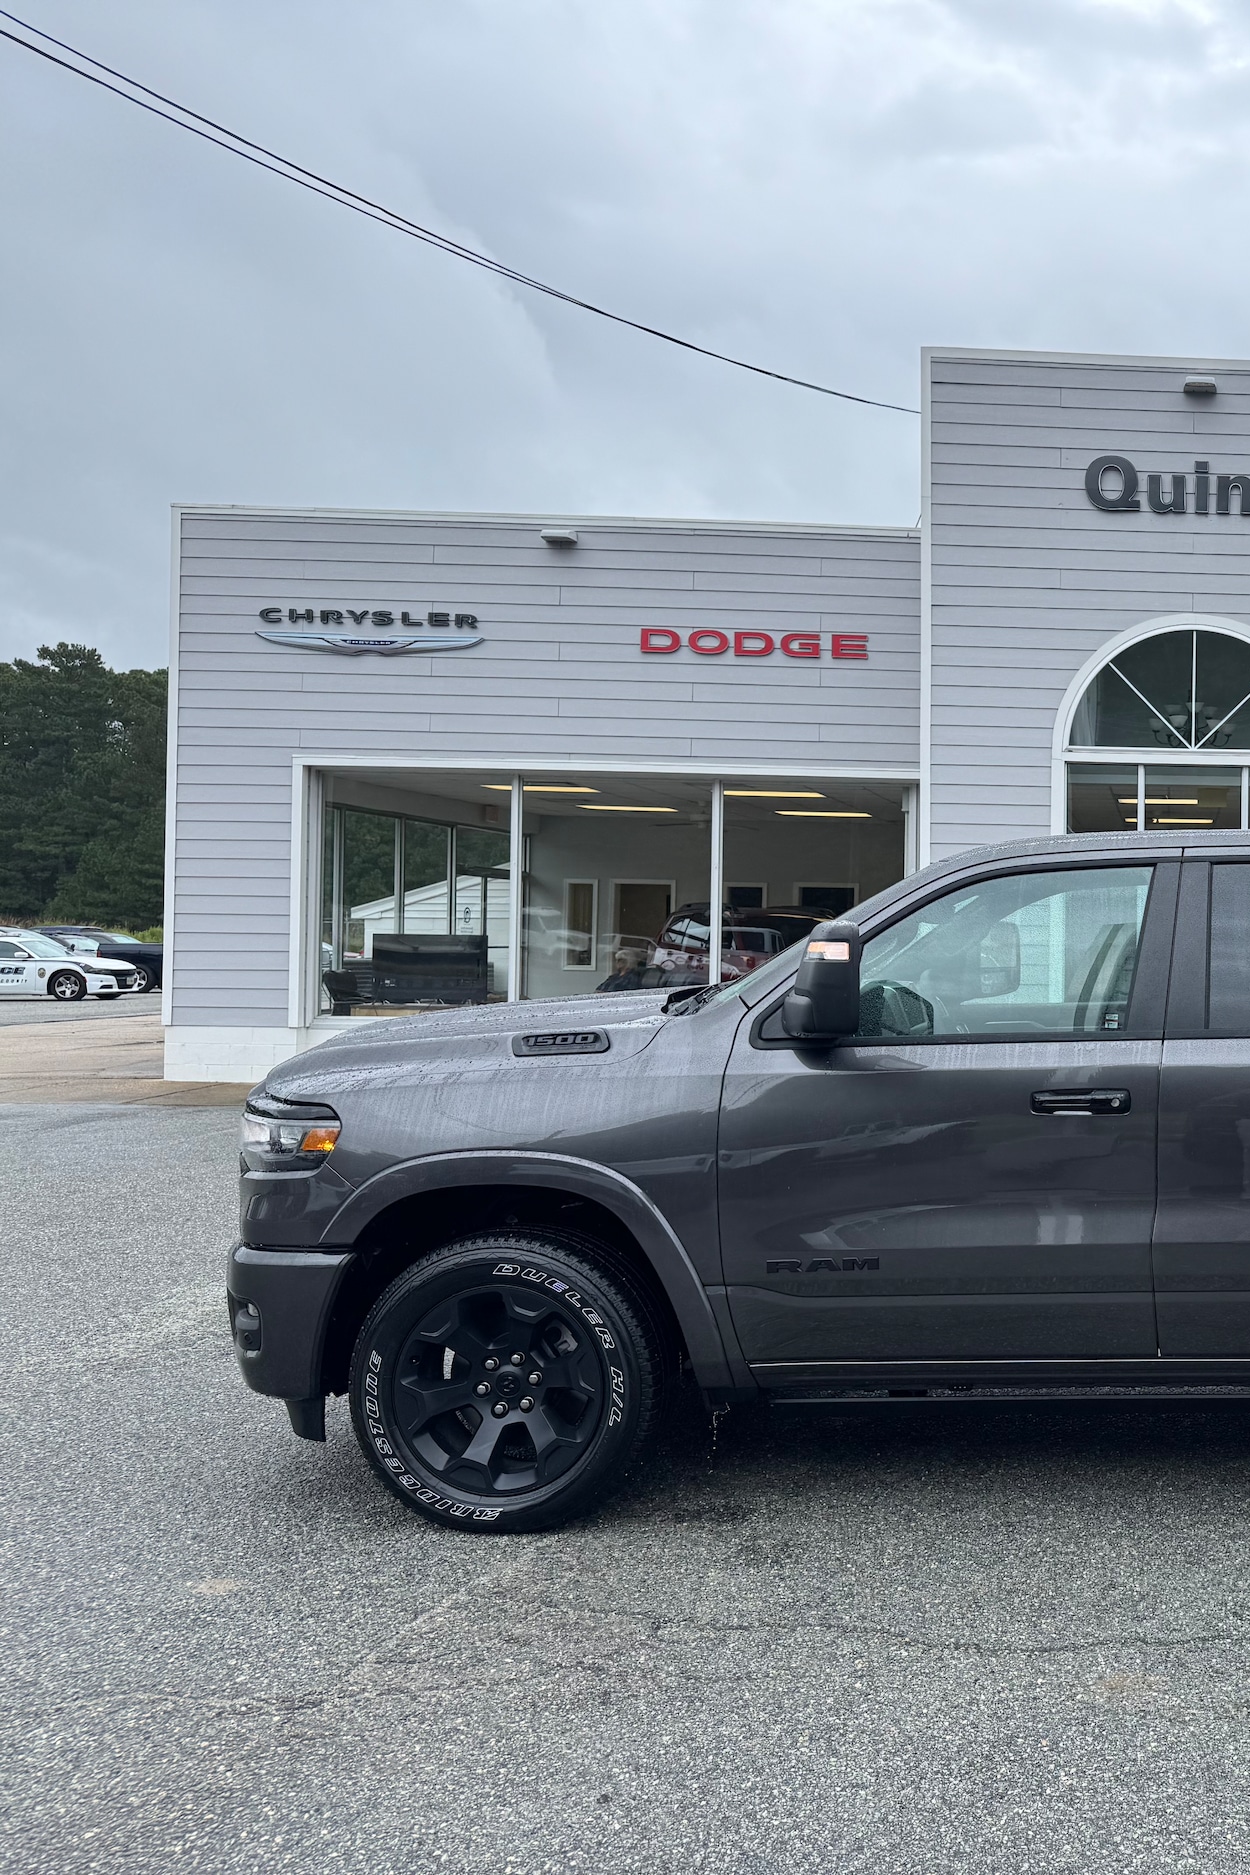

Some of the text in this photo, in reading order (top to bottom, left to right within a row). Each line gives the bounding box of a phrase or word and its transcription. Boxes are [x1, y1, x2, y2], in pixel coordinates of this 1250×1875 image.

[259, 608, 478, 628] CHRYSLER
[641, 628, 868, 659] DODGE
[527, 1034, 595, 1047] 1500
[766, 1256, 880, 1273] RAM
[493, 1263, 624, 1427] DUELER H/L
[365, 1350, 503, 1520] BRIDGESTONE
